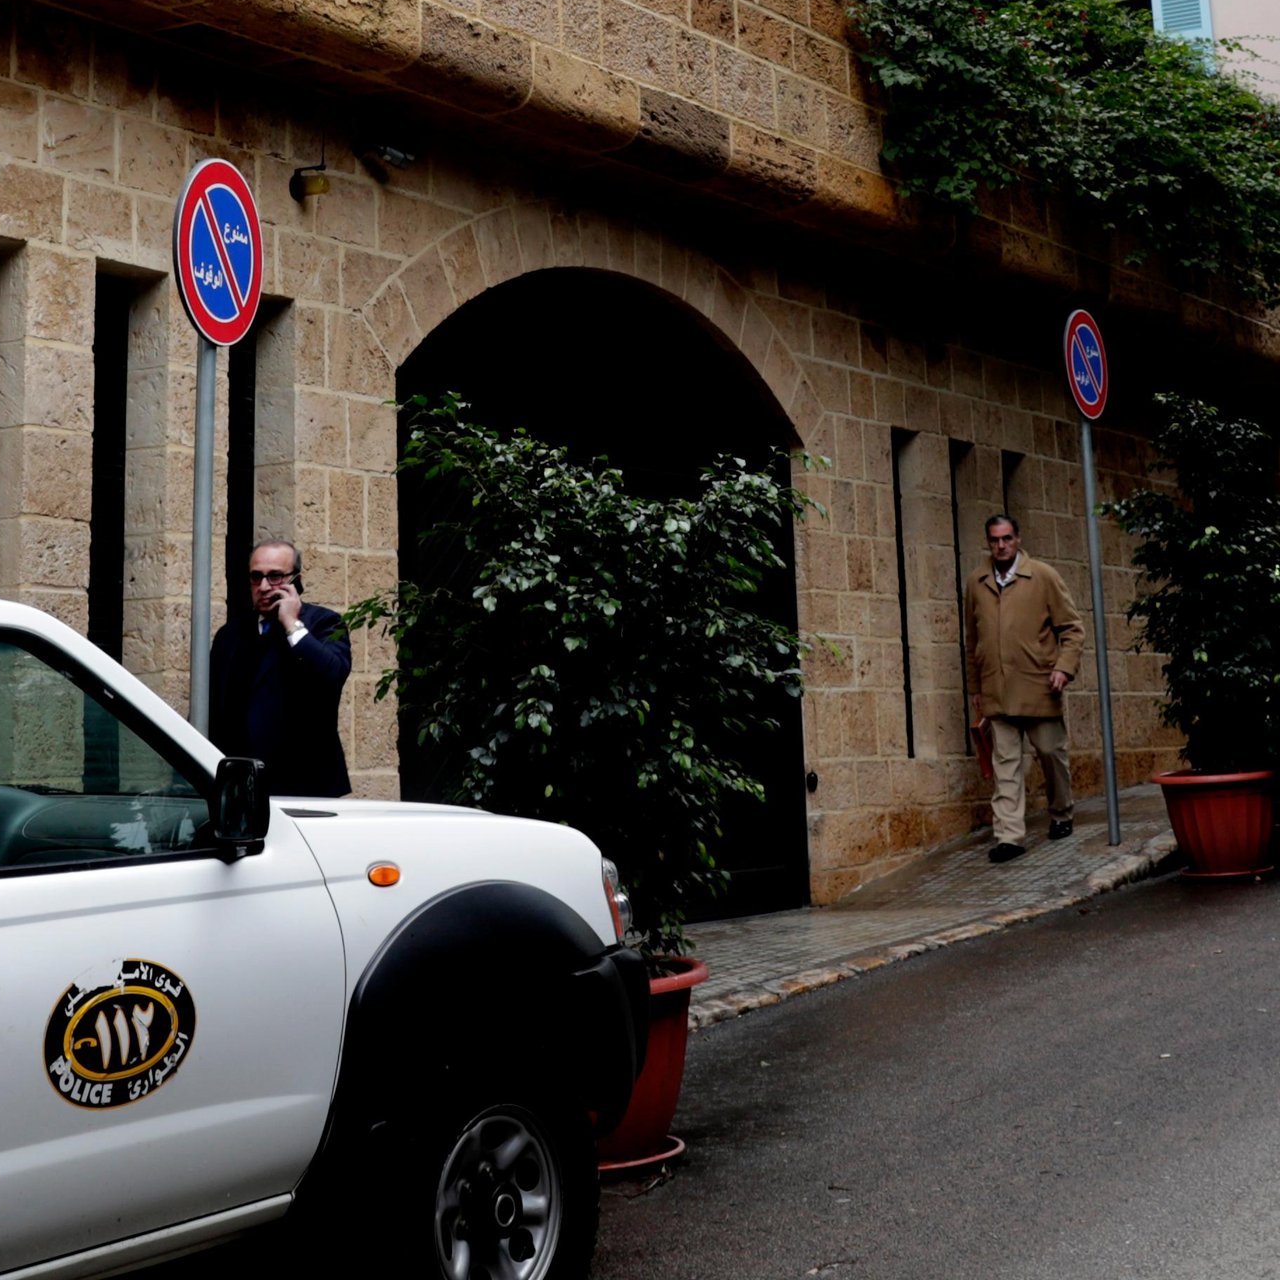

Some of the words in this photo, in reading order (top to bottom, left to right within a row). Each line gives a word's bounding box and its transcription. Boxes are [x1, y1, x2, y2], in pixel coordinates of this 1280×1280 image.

[223, 222, 248, 245] ممنوع
[193, 262, 223, 289] الوقوف
[50, 1056, 113, 1105] POLICE
